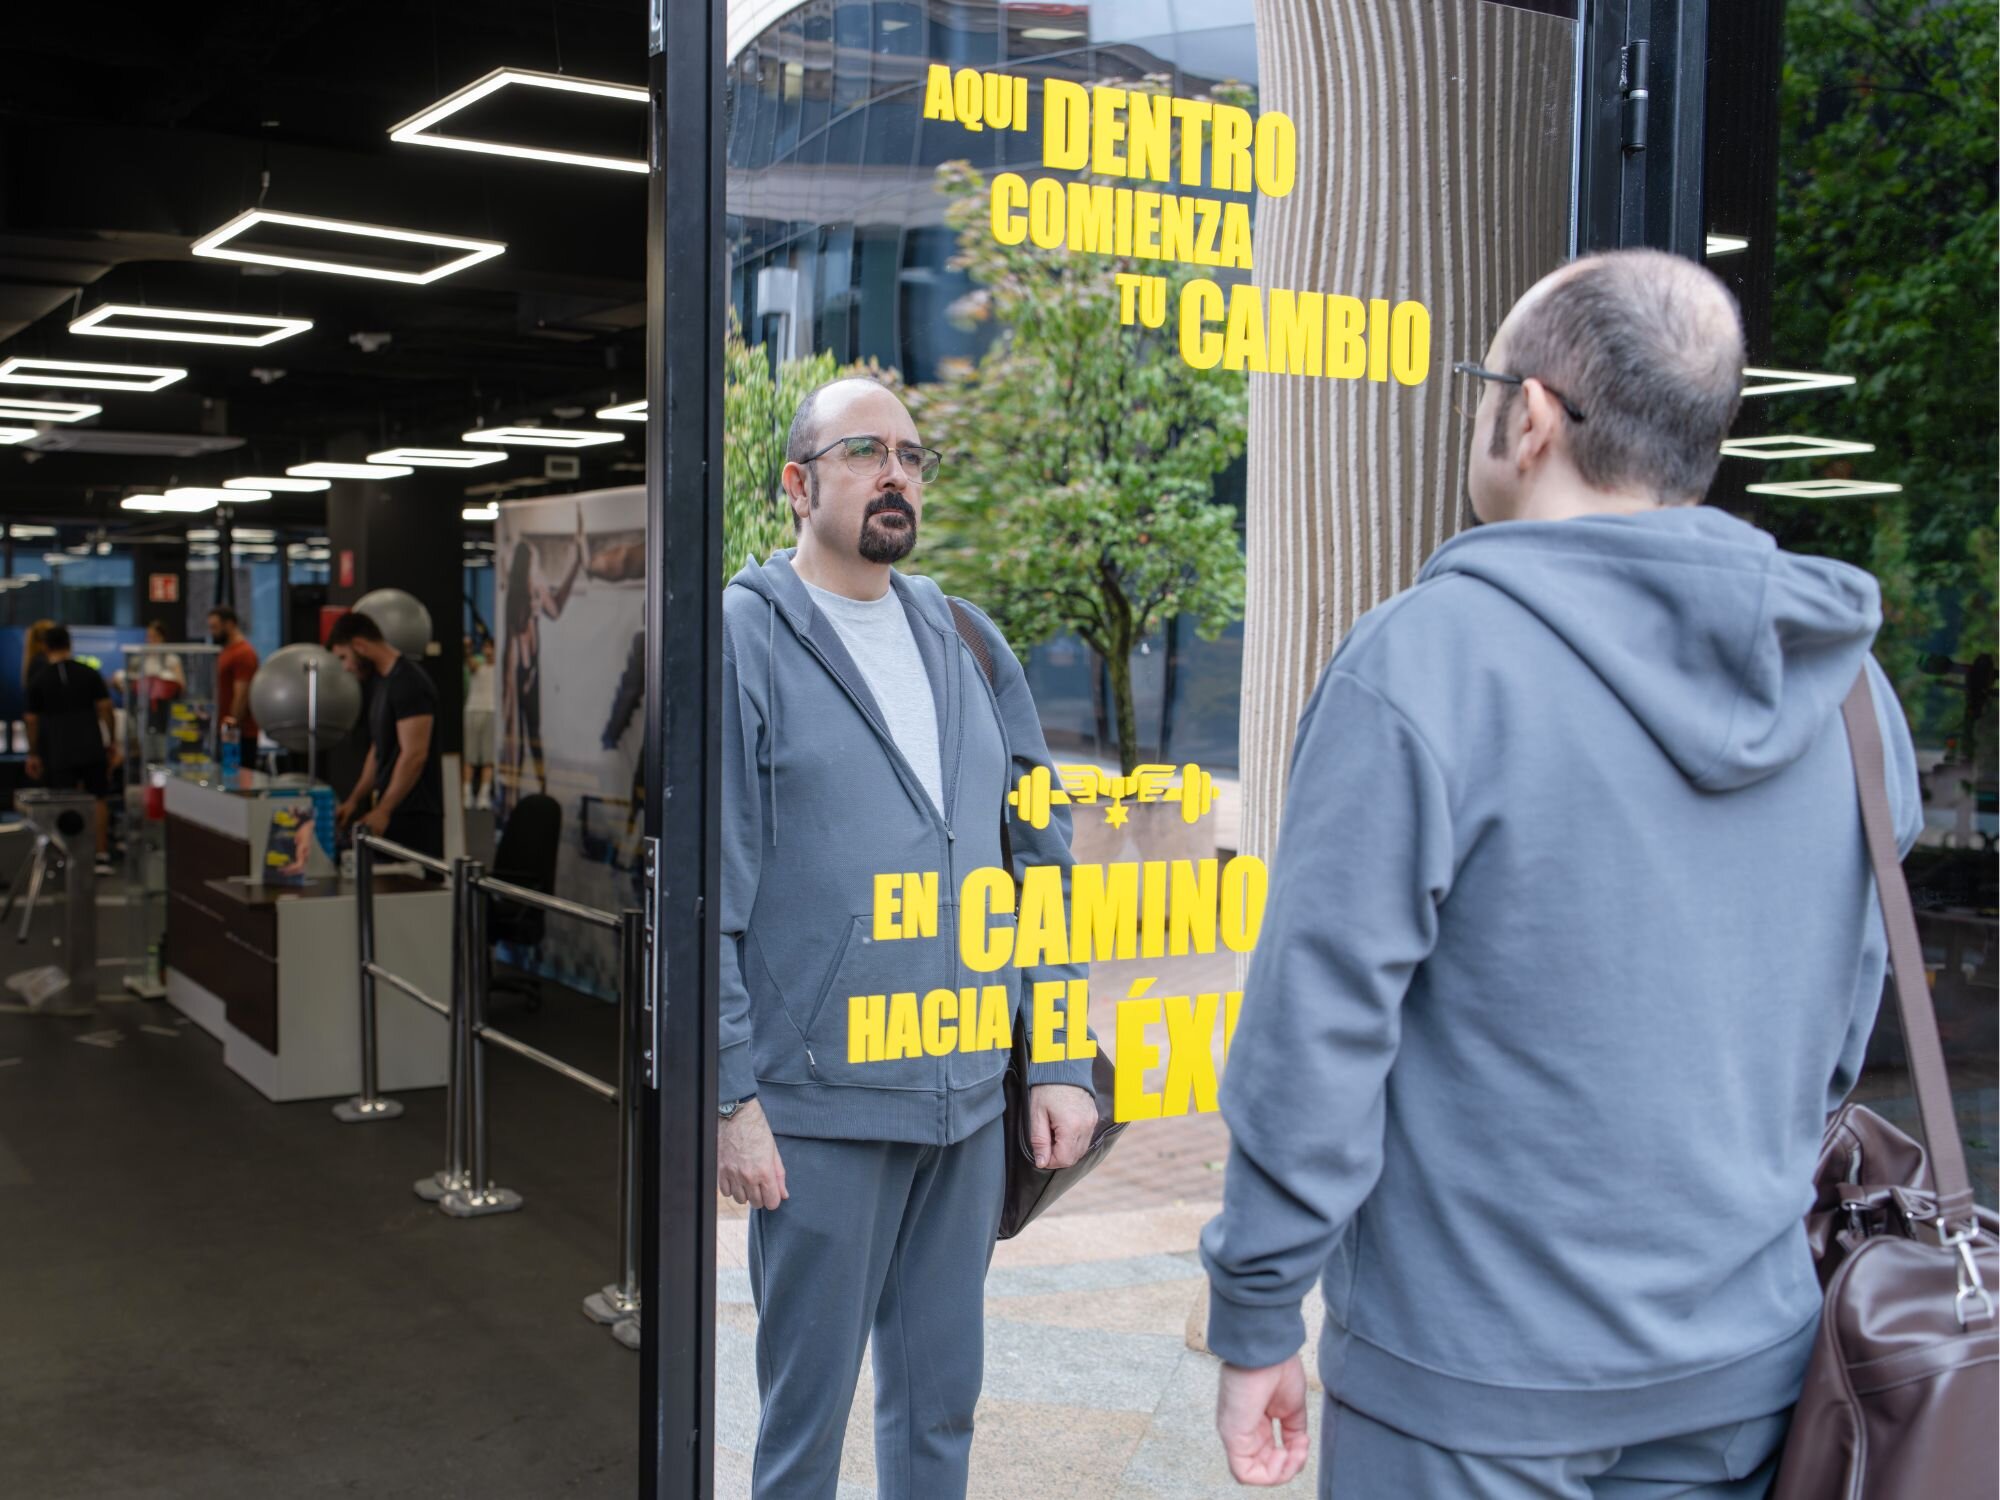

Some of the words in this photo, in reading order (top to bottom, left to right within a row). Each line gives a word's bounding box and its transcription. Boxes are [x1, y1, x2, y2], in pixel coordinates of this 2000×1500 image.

[923, 64, 1028, 132] AQUI
[1043, 78, 1296, 198] DENTRO
[990, 172, 1253, 270] COMIENZA
[1115, 272, 1167, 329] TU
[1179, 278, 1431, 386] CAMBIO
[873, 871, 939, 941] EN
[959, 855, 1269, 973] CAMINO
[847, 985, 1013, 1064] HACIA
[1032, 979, 1098, 1064] EL
[1114, 977, 1244, 1123] ÉX
